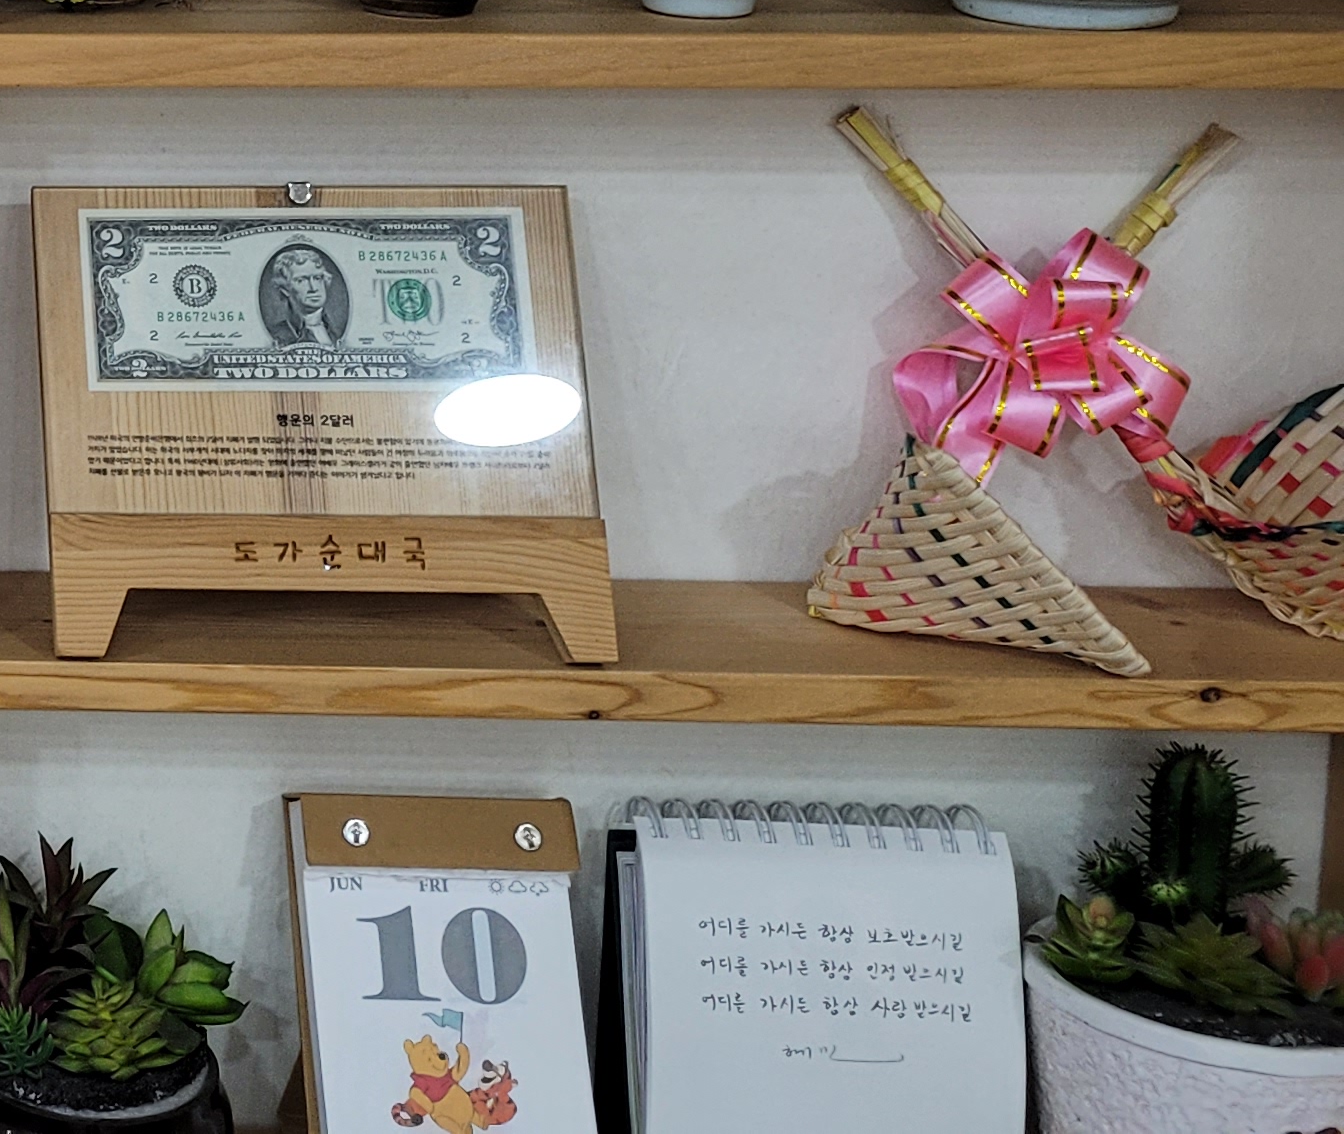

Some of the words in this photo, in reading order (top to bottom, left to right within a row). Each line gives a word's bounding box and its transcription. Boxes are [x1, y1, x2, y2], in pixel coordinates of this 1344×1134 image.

[148, 224, 169, 232] TWO
[170, 224, 218, 232] DOLLARS
[379, 223, 401, 231] TWO
[402, 223, 451, 232] DOLLARS
[100, 228, 124, 258] 2
[476, 226, 502, 257] 2
[149, 273, 159, 285] 2
[188, 277, 203, 295] B
[452, 275, 462, 287] 2
[149, 330, 159, 342] 2
[461, 333, 471, 344] 2
[213, 354, 265, 365] UNITED
[266, 354, 321, 365] STATES
[339, 354, 408, 364] AMERICA
[213, 366, 274, 380] TWO
[276, 366, 409, 380] DOLLARS
[277, 413, 315, 428] 행운의
[320, 413, 355, 428] 2달러
[330, 876, 362, 893] JUN
[419, 878, 449, 893] FRI
[817, 923, 855, 944] 항상
[355, 905, 527, 1003] 10
[819, 959, 854, 981] 항상
[822, 996, 859, 1017] 항상
